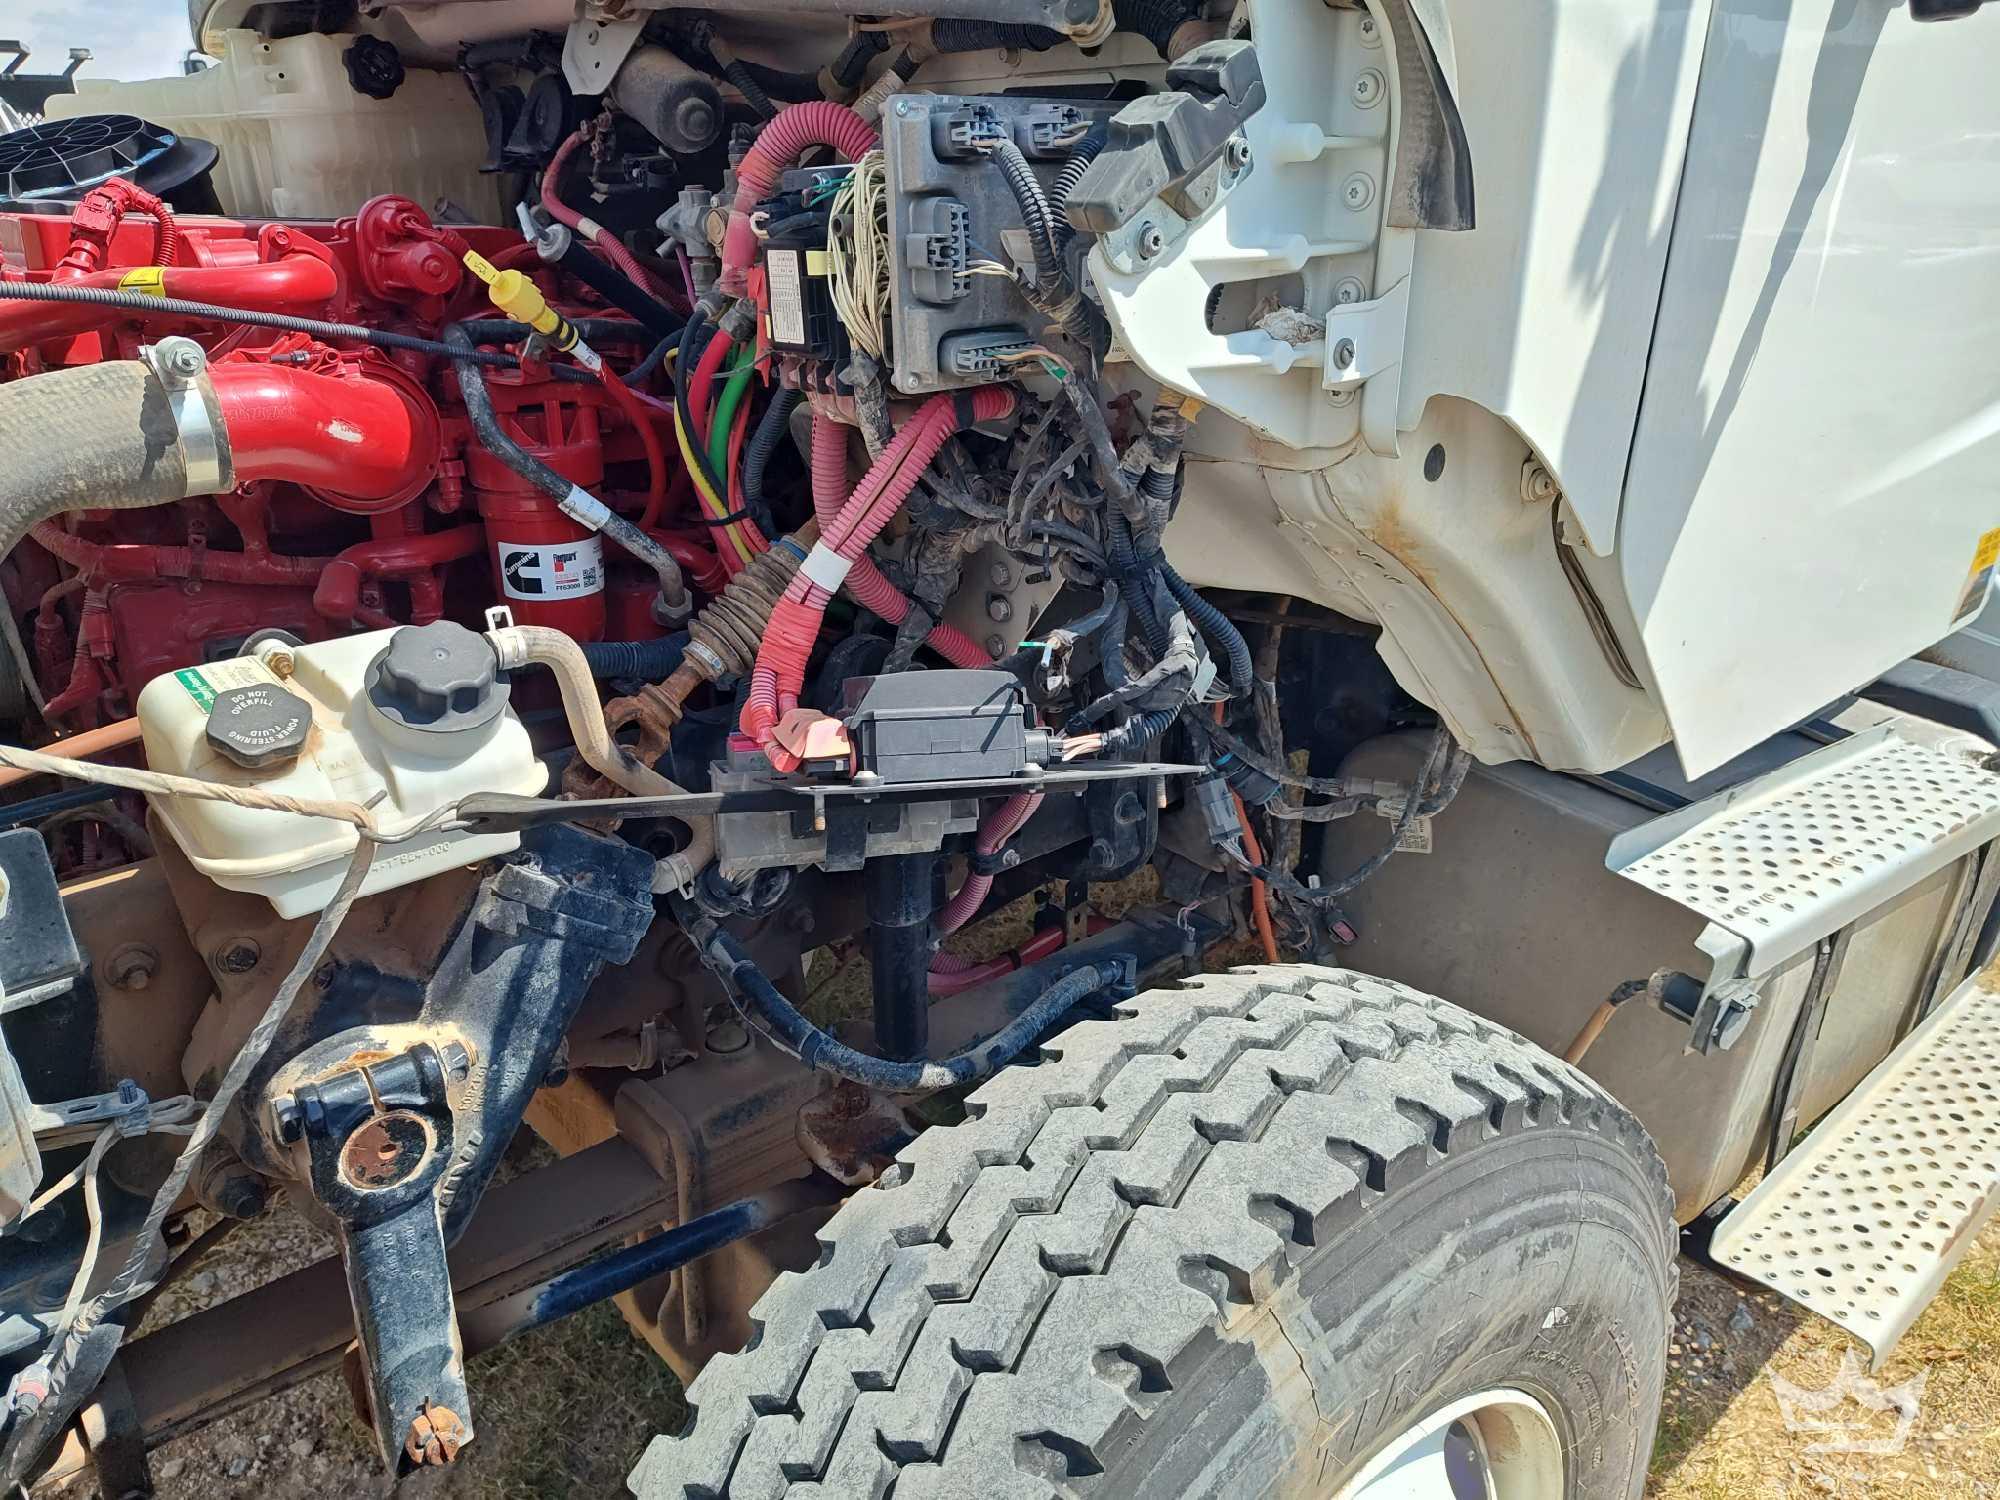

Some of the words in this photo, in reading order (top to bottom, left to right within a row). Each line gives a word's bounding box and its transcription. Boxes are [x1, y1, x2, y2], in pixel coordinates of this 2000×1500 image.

[505, 552, 536, 576] Cummins
[231, 694, 245, 704] DO
[248, 690, 268, 698] NOT
[231, 698, 274, 716] OVERFILL
[250, 725, 282, 737] FLUID
[275, 718, 299, 739] POWER
[228, 730, 276, 745] STEERING
